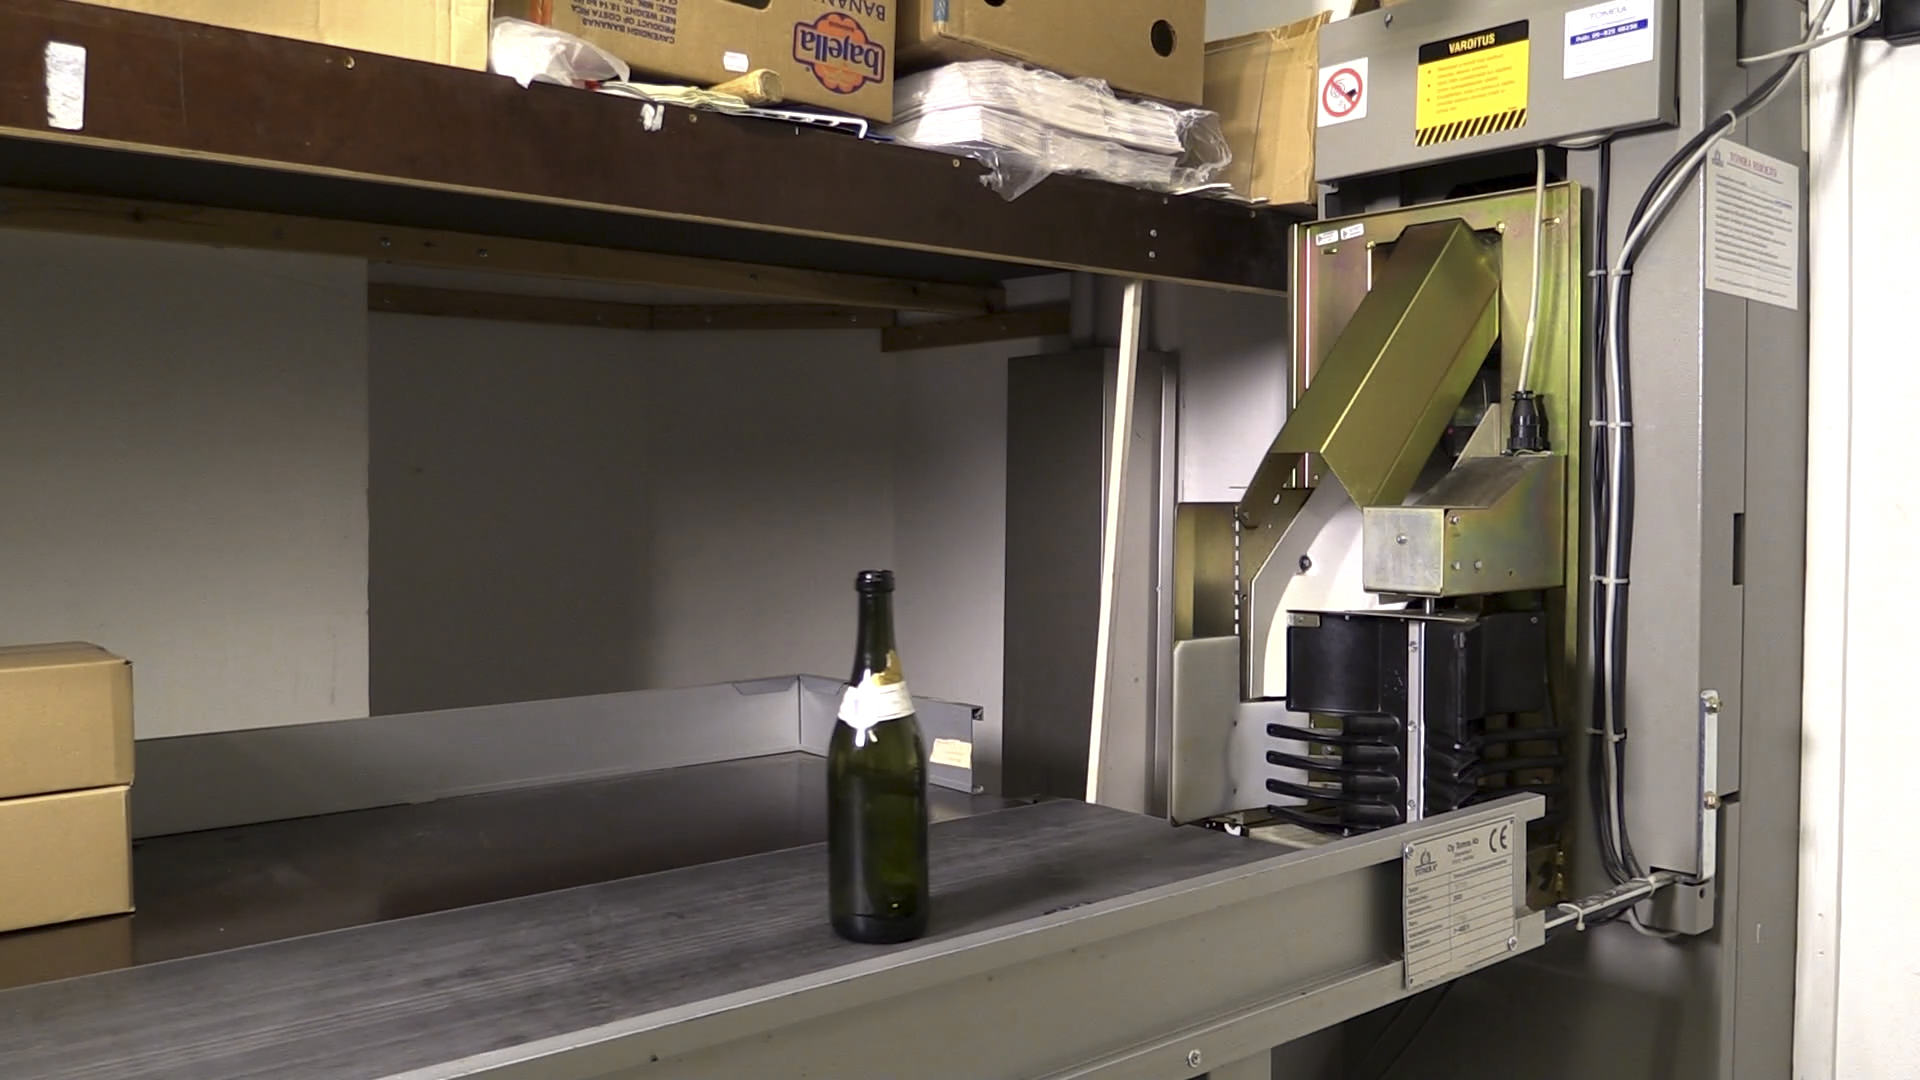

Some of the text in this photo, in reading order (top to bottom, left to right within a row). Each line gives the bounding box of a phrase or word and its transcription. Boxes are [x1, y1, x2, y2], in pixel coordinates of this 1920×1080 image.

[570, 4, 676, 35] PRODUCT OF COSTA RICA
[582, 18, 676, 44] CAVENDISH BANANAS
[660, 14, 676, 25] NET
[800, 29, 879, 76] bajella
[1448, 32, 1496, 54] VAROITUS
